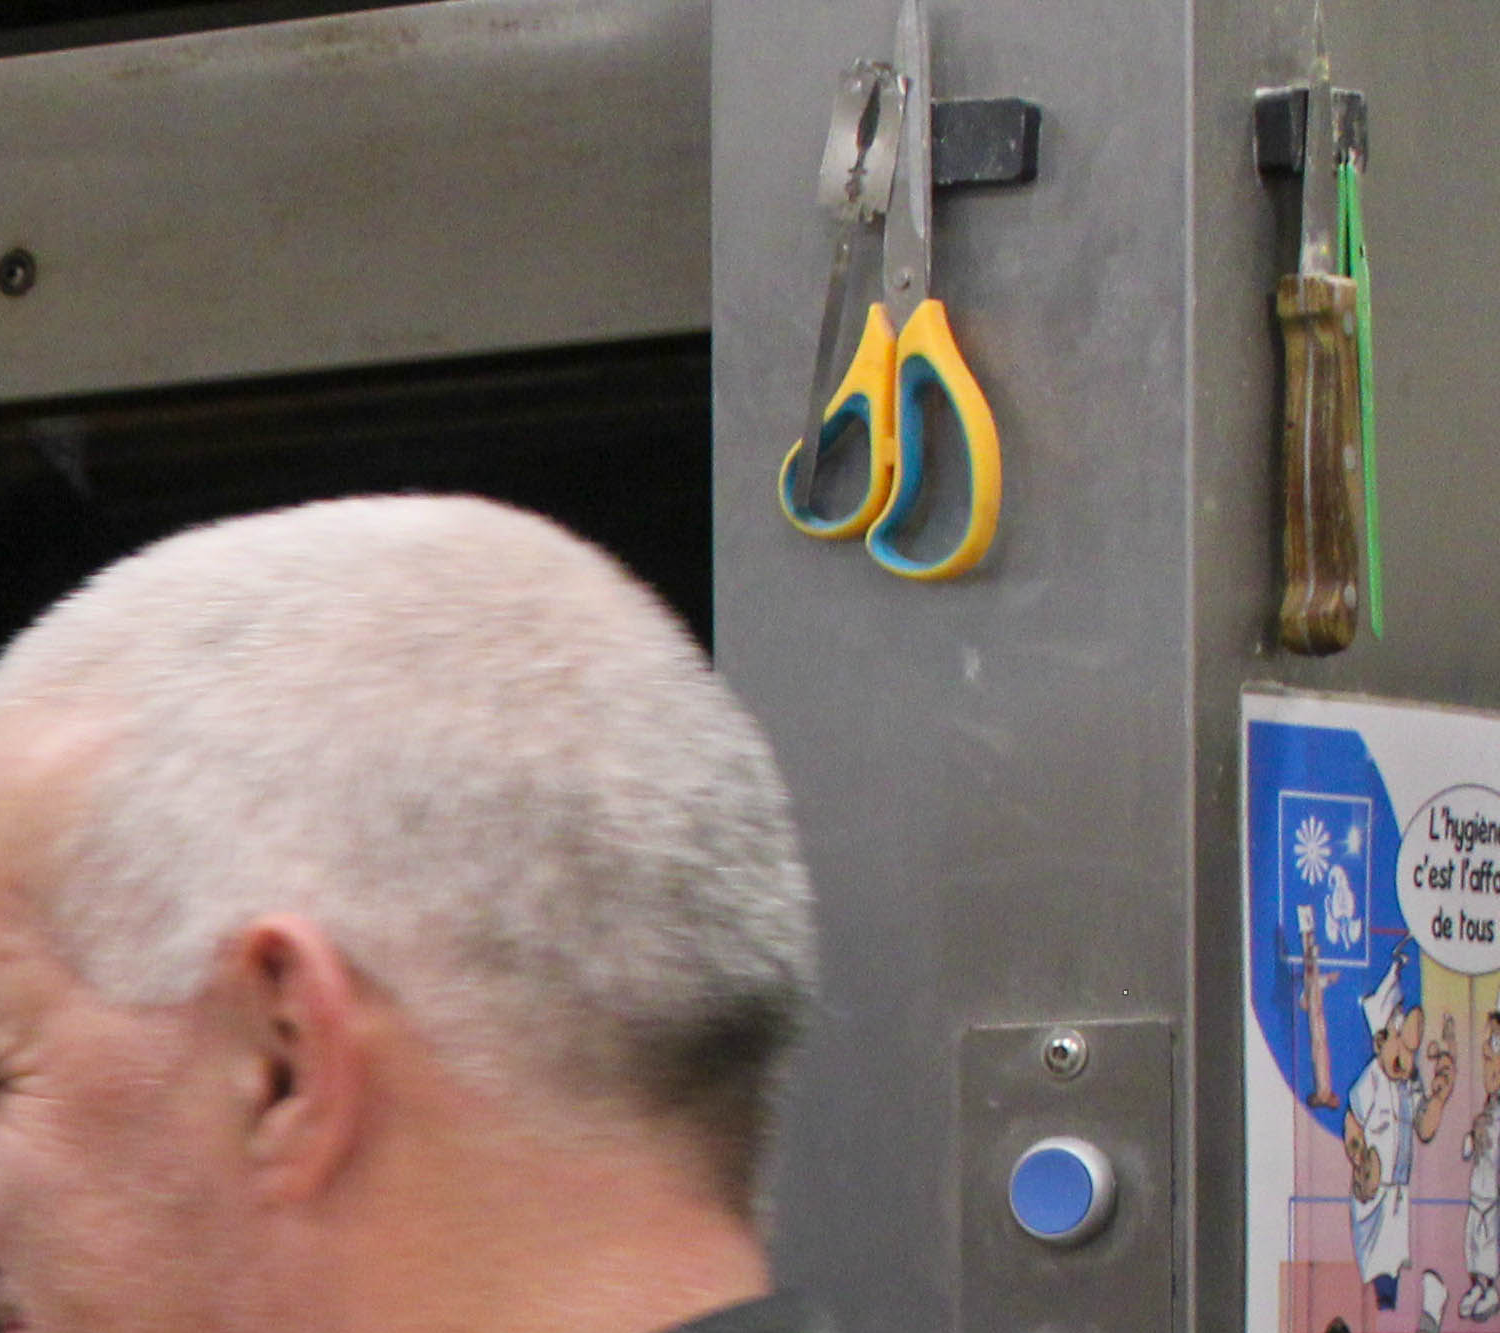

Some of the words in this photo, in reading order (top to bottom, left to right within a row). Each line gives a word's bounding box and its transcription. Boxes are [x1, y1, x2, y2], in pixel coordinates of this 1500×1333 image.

[1429, 806, 1500, 851] L'hygièn
[1413, 854, 1454, 889] c'est
[1431, 906, 1453, 939] de
[1459, 909, 1494, 942] tous
